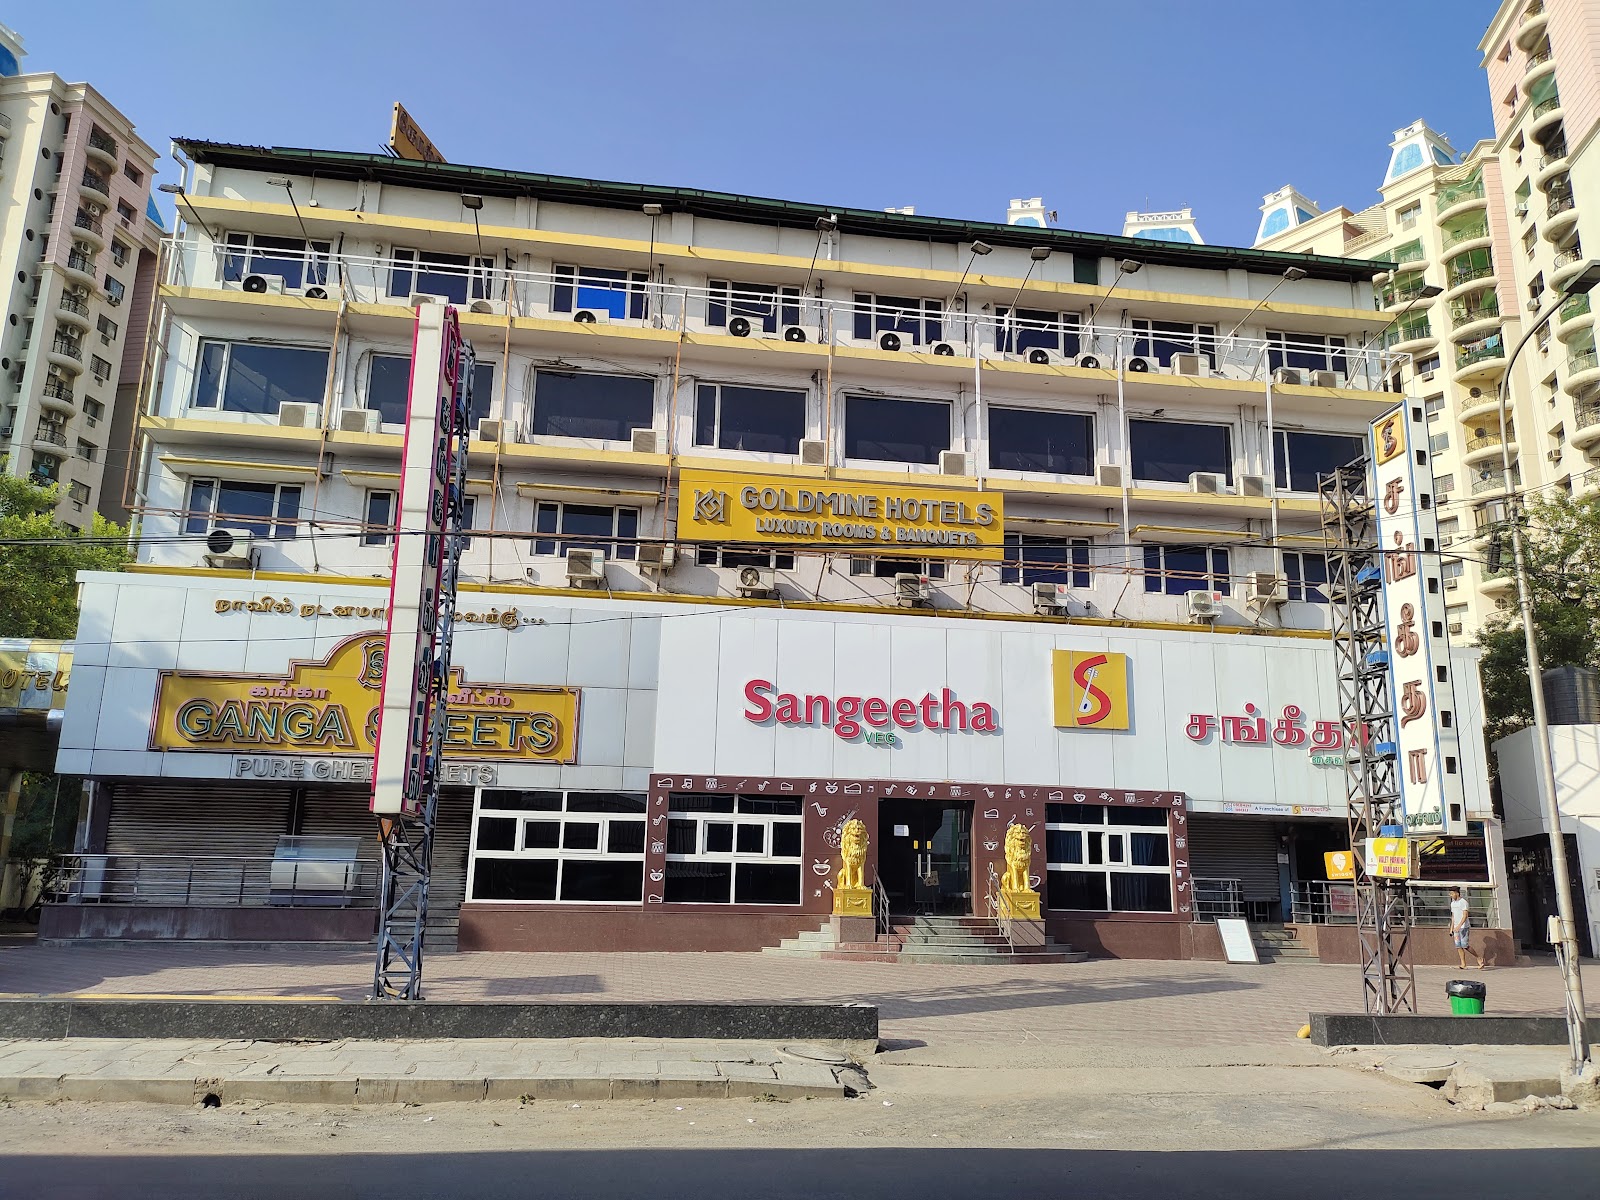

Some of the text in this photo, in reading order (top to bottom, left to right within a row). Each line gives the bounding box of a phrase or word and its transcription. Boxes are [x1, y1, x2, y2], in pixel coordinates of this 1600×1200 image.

[739, 486, 994, 526] GOLDMINE HOTELS
[755, 517, 978, 546] LUXURY ROOMS & BANQUETS
[215, 596, 293, 613] நாவில்
[1383, 476, 1428, 786] சங்கீதா
[0, 668, 70, 692] OTEL
[249, 680, 328, 699] கங்கா
[744, 679, 998, 738] Sangeetha
[177, 701, 351, 744] GANGA
[1184, 702, 1370, 756] சங்கீதா
[862, 731, 896, 744] VEG
[235, 758, 304, 779] PURE
[1311, 756, 1344, 766] சைவ
[1382, 866, 1402, 874] AVAILABLE
[1389, 856, 1407, 864] PARKING
